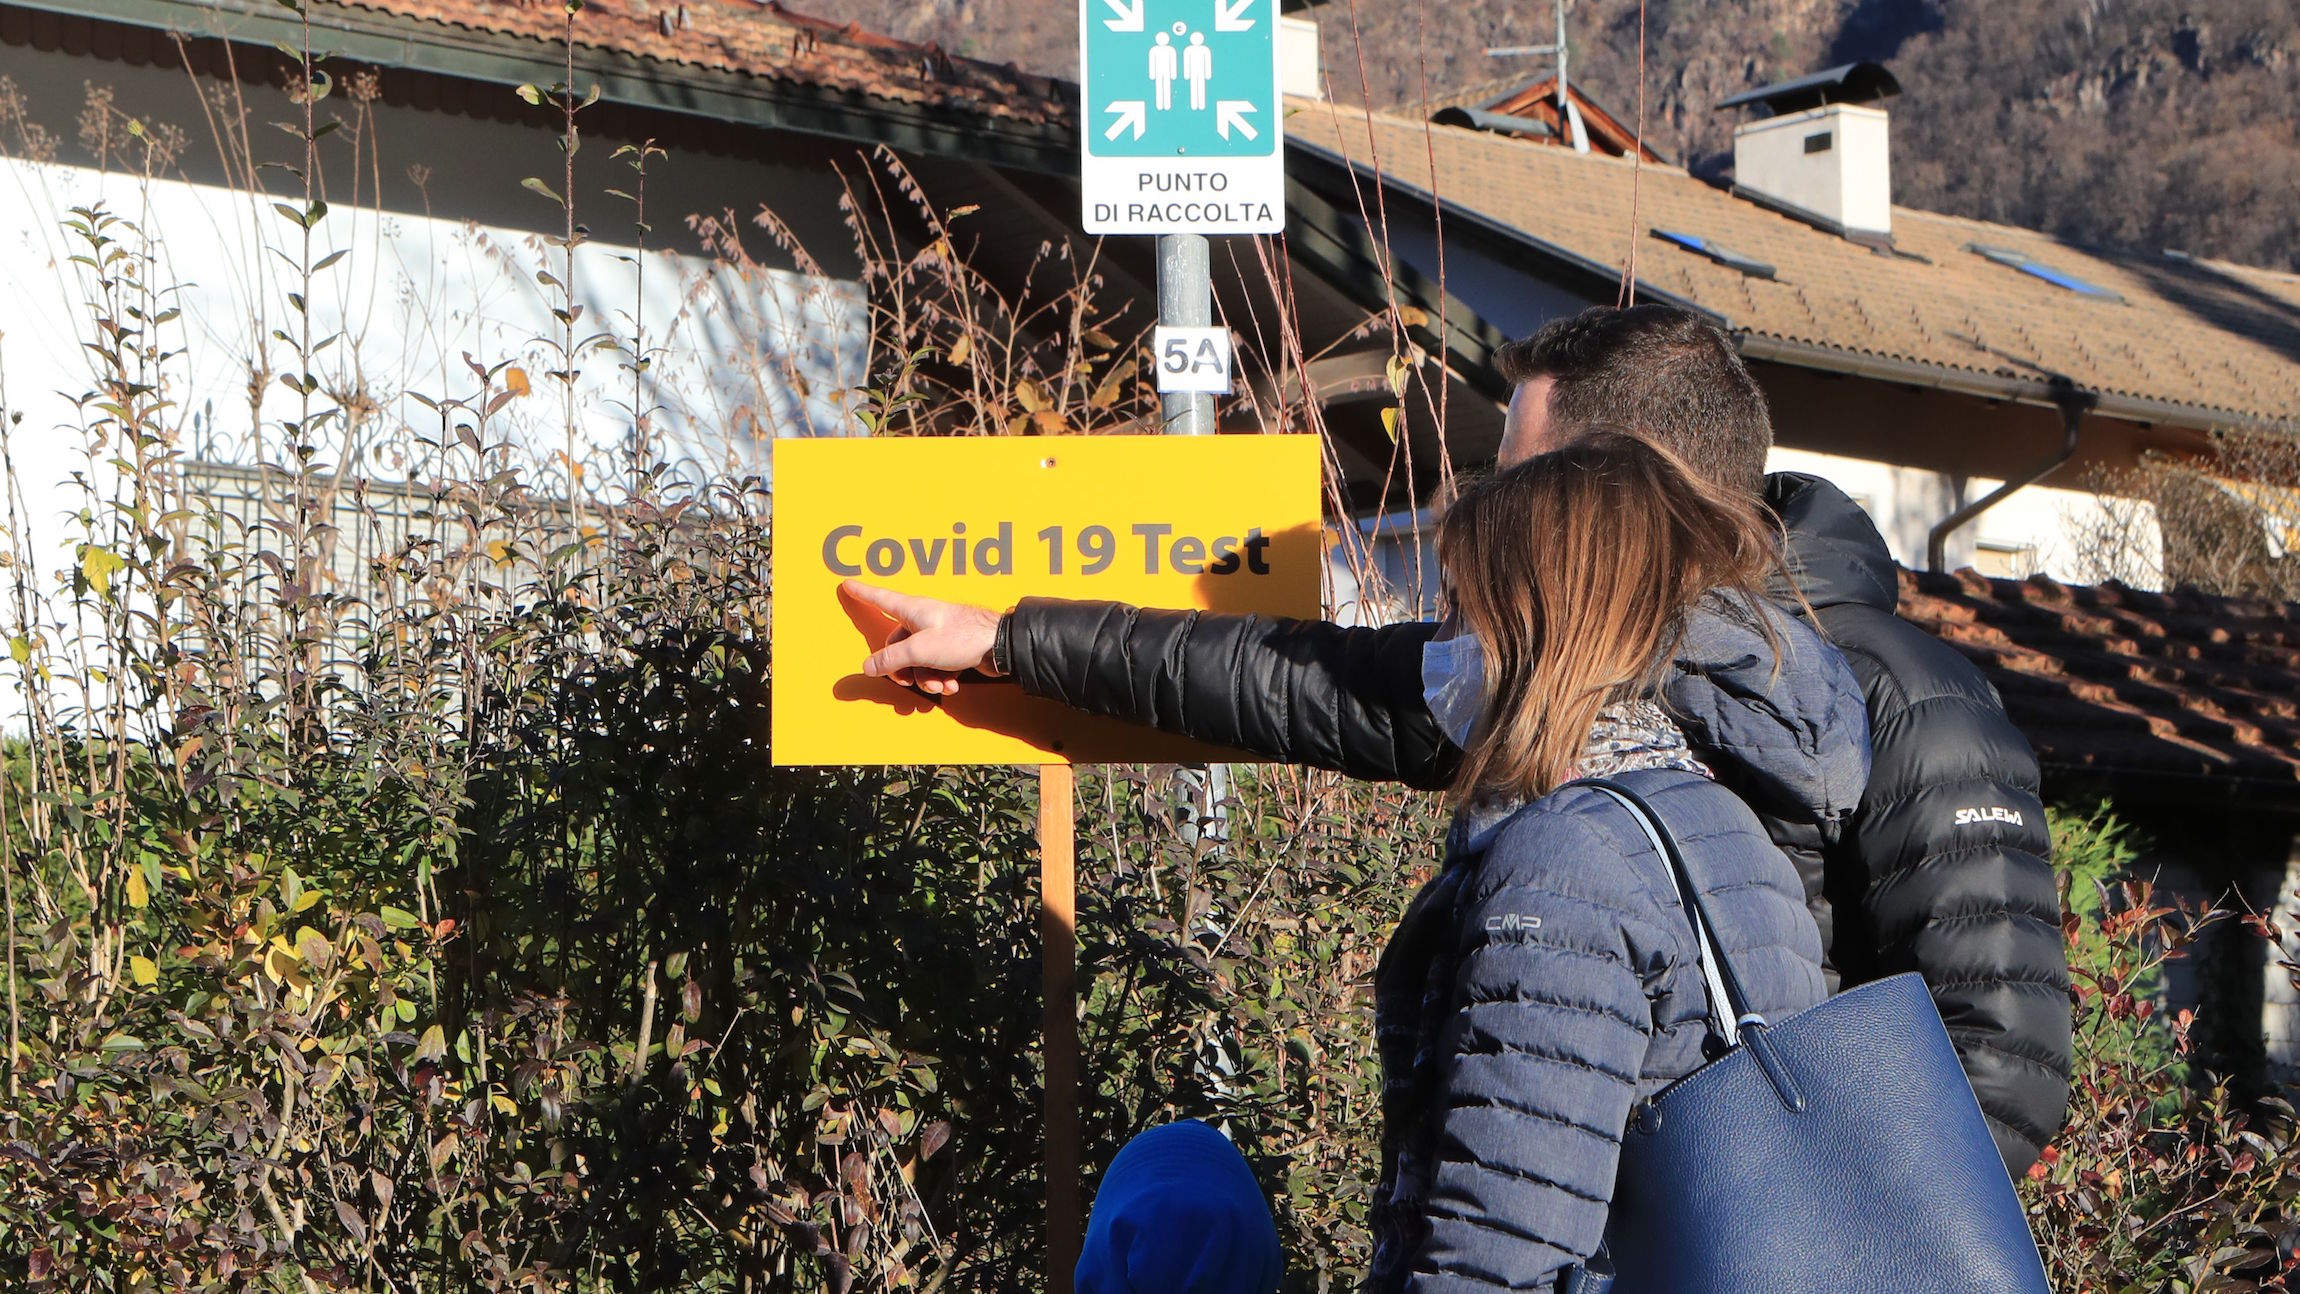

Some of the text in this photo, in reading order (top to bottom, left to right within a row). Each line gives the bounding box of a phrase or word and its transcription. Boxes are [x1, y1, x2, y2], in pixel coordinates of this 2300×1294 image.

[1138, 172, 1228, 192] PUNTO
[1094, 203, 1273, 222] DI RACCOLTA
[1163, 338, 1223, 374] 5A
[821, 521, 1270, 576] Covid 19 Test
[1955, 806, 2024, 826] SALEWA
[1485, 913, 1542, 931] CMP
